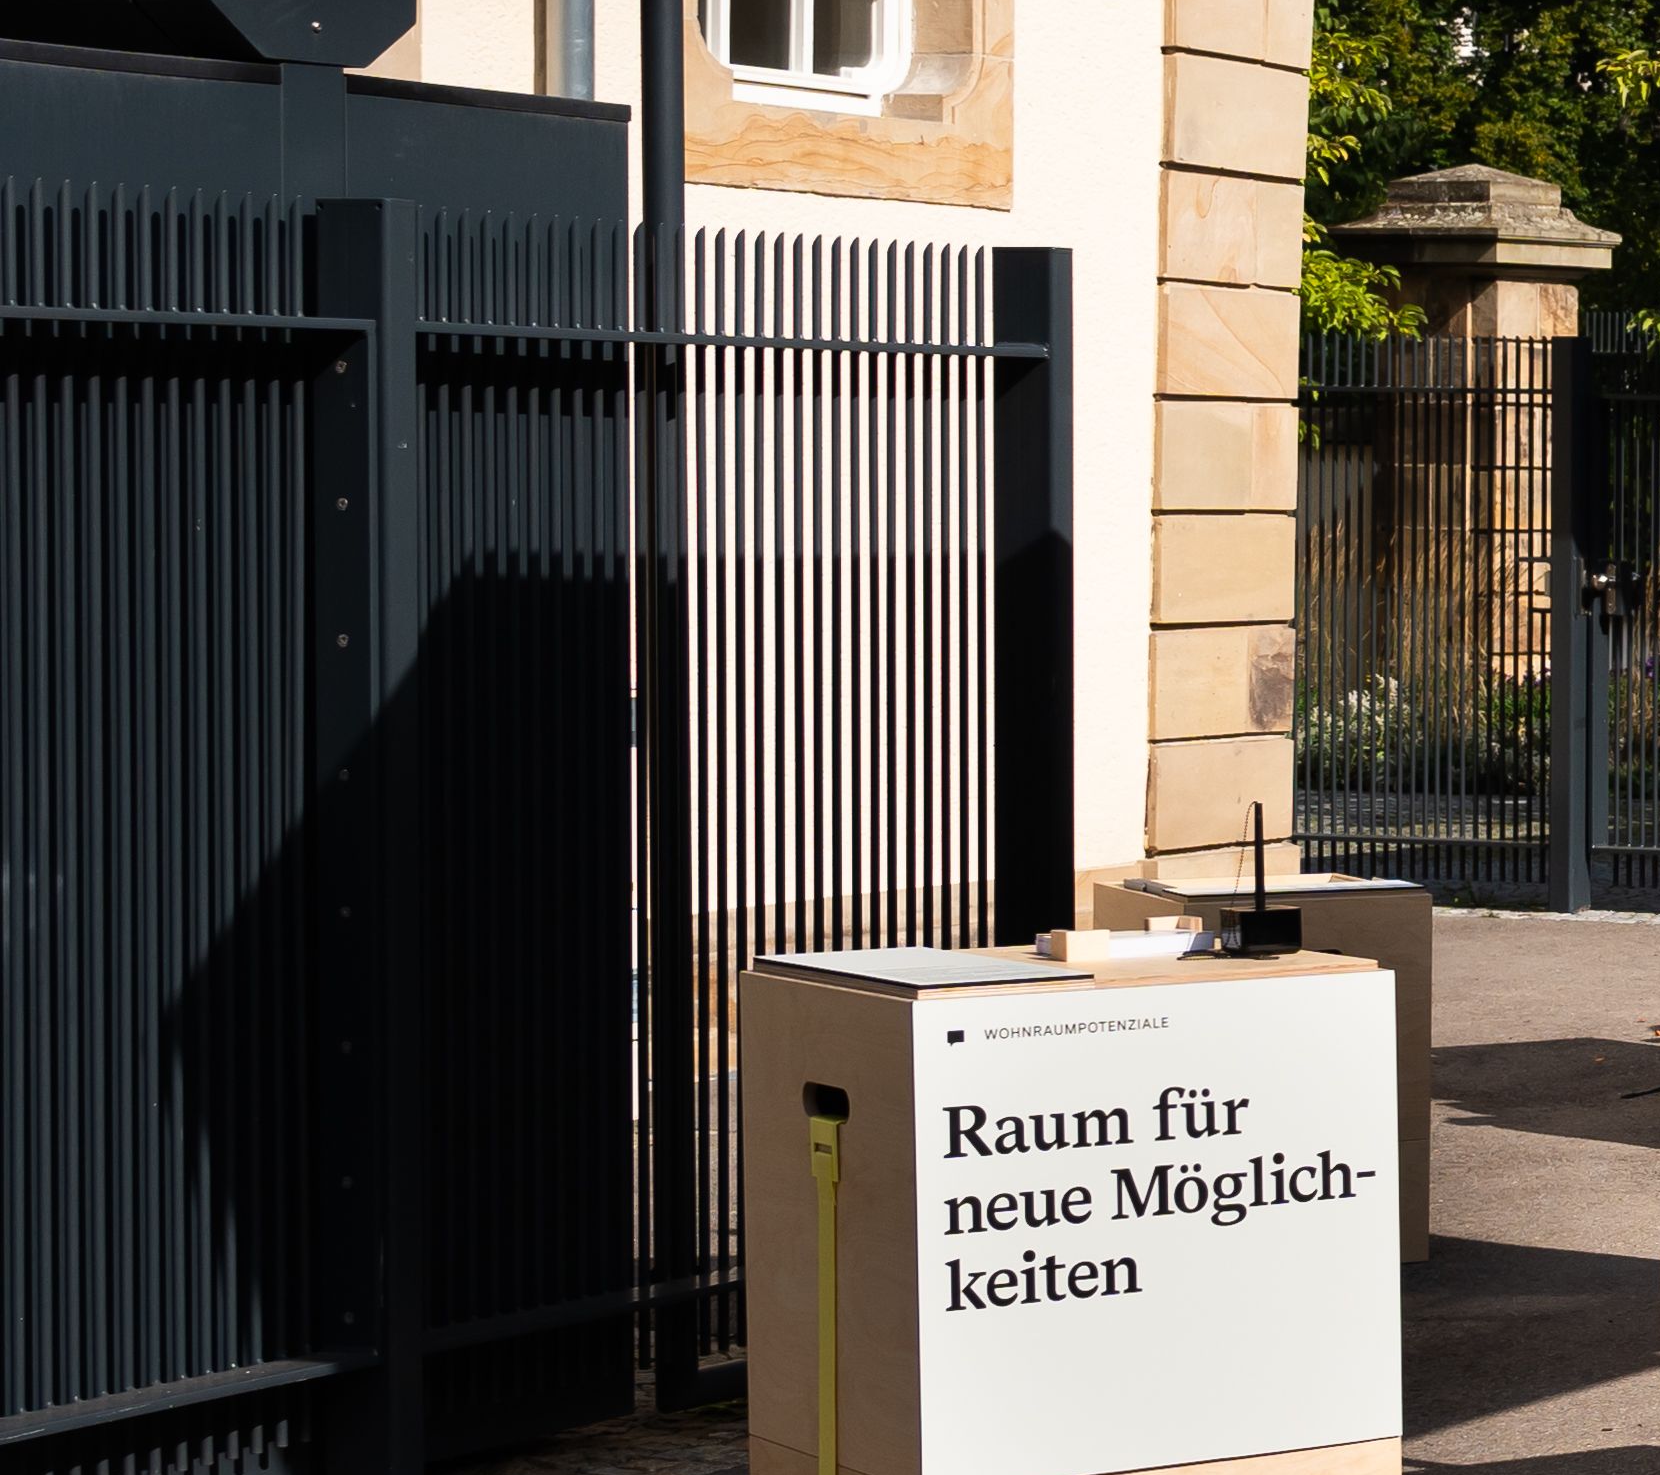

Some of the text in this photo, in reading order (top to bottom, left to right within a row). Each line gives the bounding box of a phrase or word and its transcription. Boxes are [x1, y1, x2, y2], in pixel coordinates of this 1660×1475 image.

[984, 1016, 1169, 1041] WOHNRAUMPOTENZIALE
[943, 1088, 1248, 1158] Raum für
[944, 1151, 1374, 1235] neue Möglich-
[944, 1251, 1142, 1311] keiten
